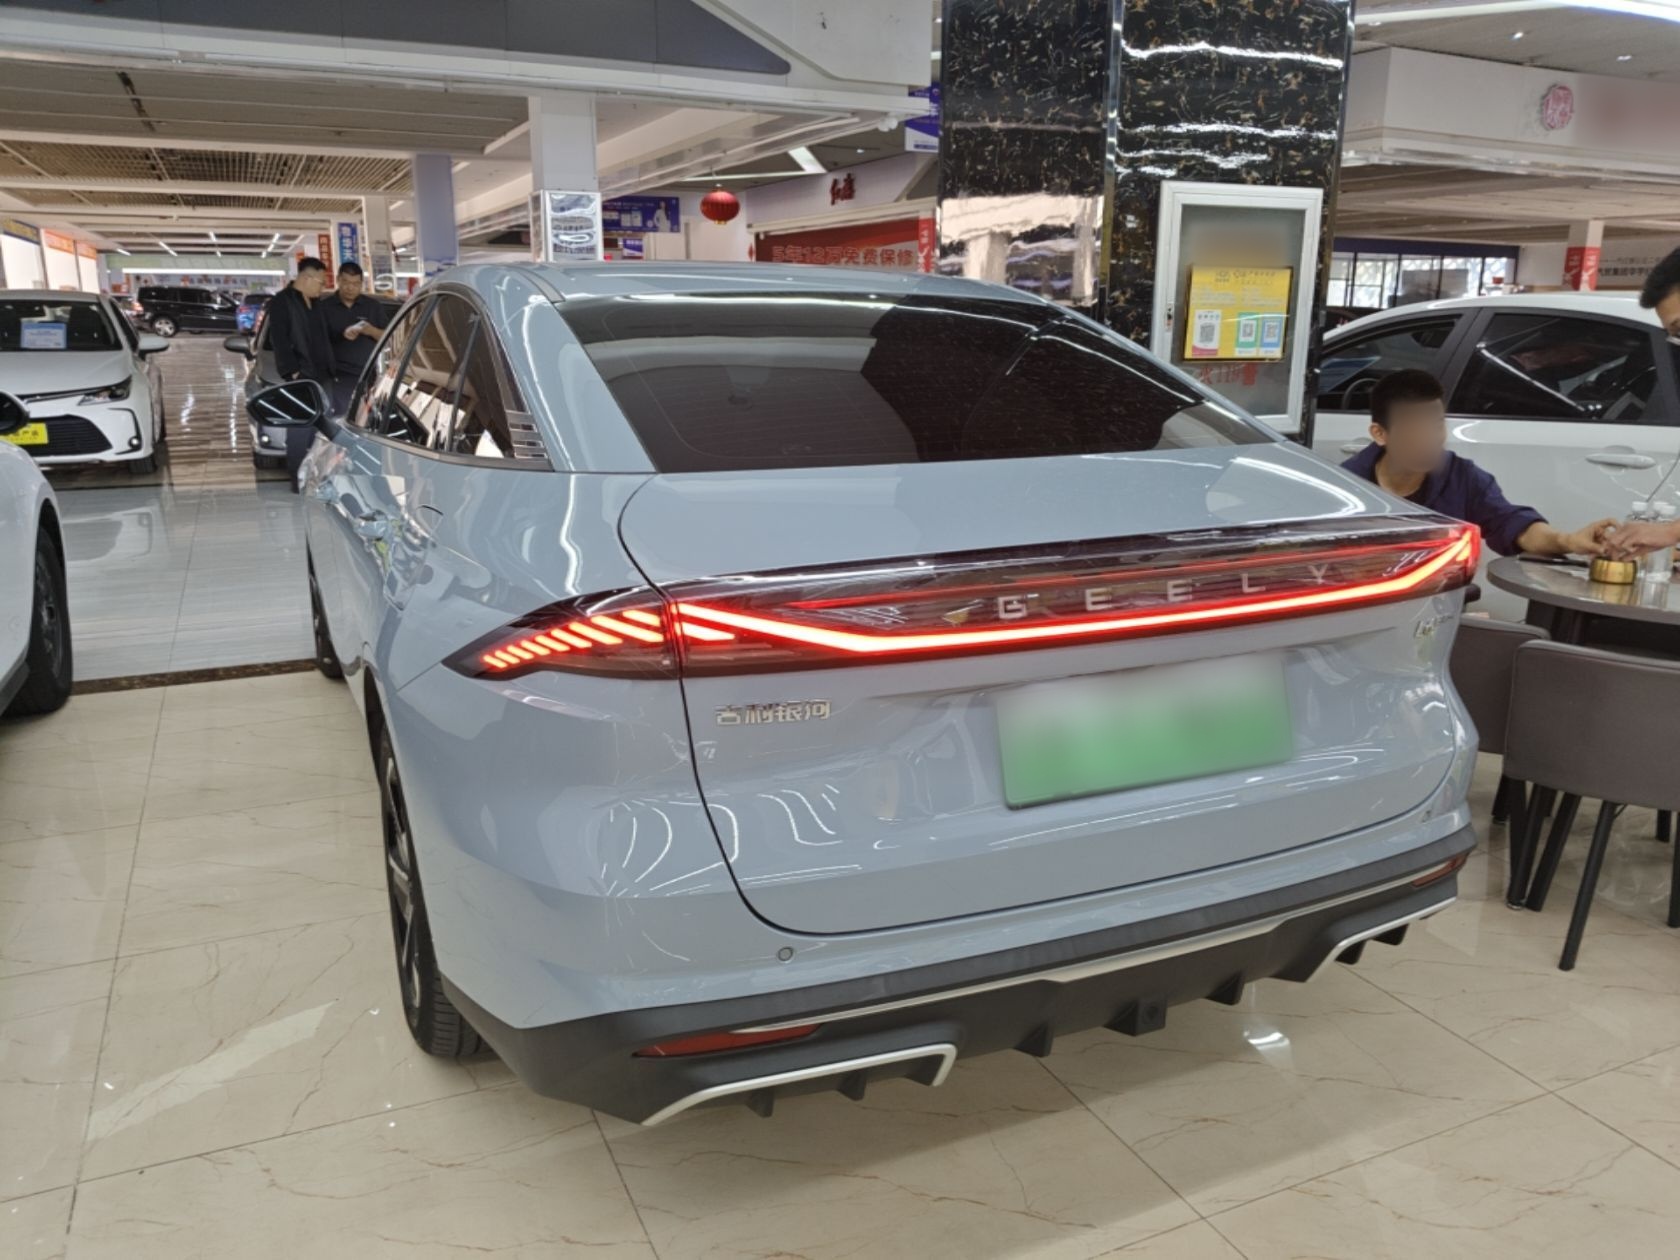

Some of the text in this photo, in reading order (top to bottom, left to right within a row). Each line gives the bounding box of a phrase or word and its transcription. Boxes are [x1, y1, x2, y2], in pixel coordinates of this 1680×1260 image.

[997, 563, 1329, 619] GEELY
[714, 699, 832, 725] 吉利银河
